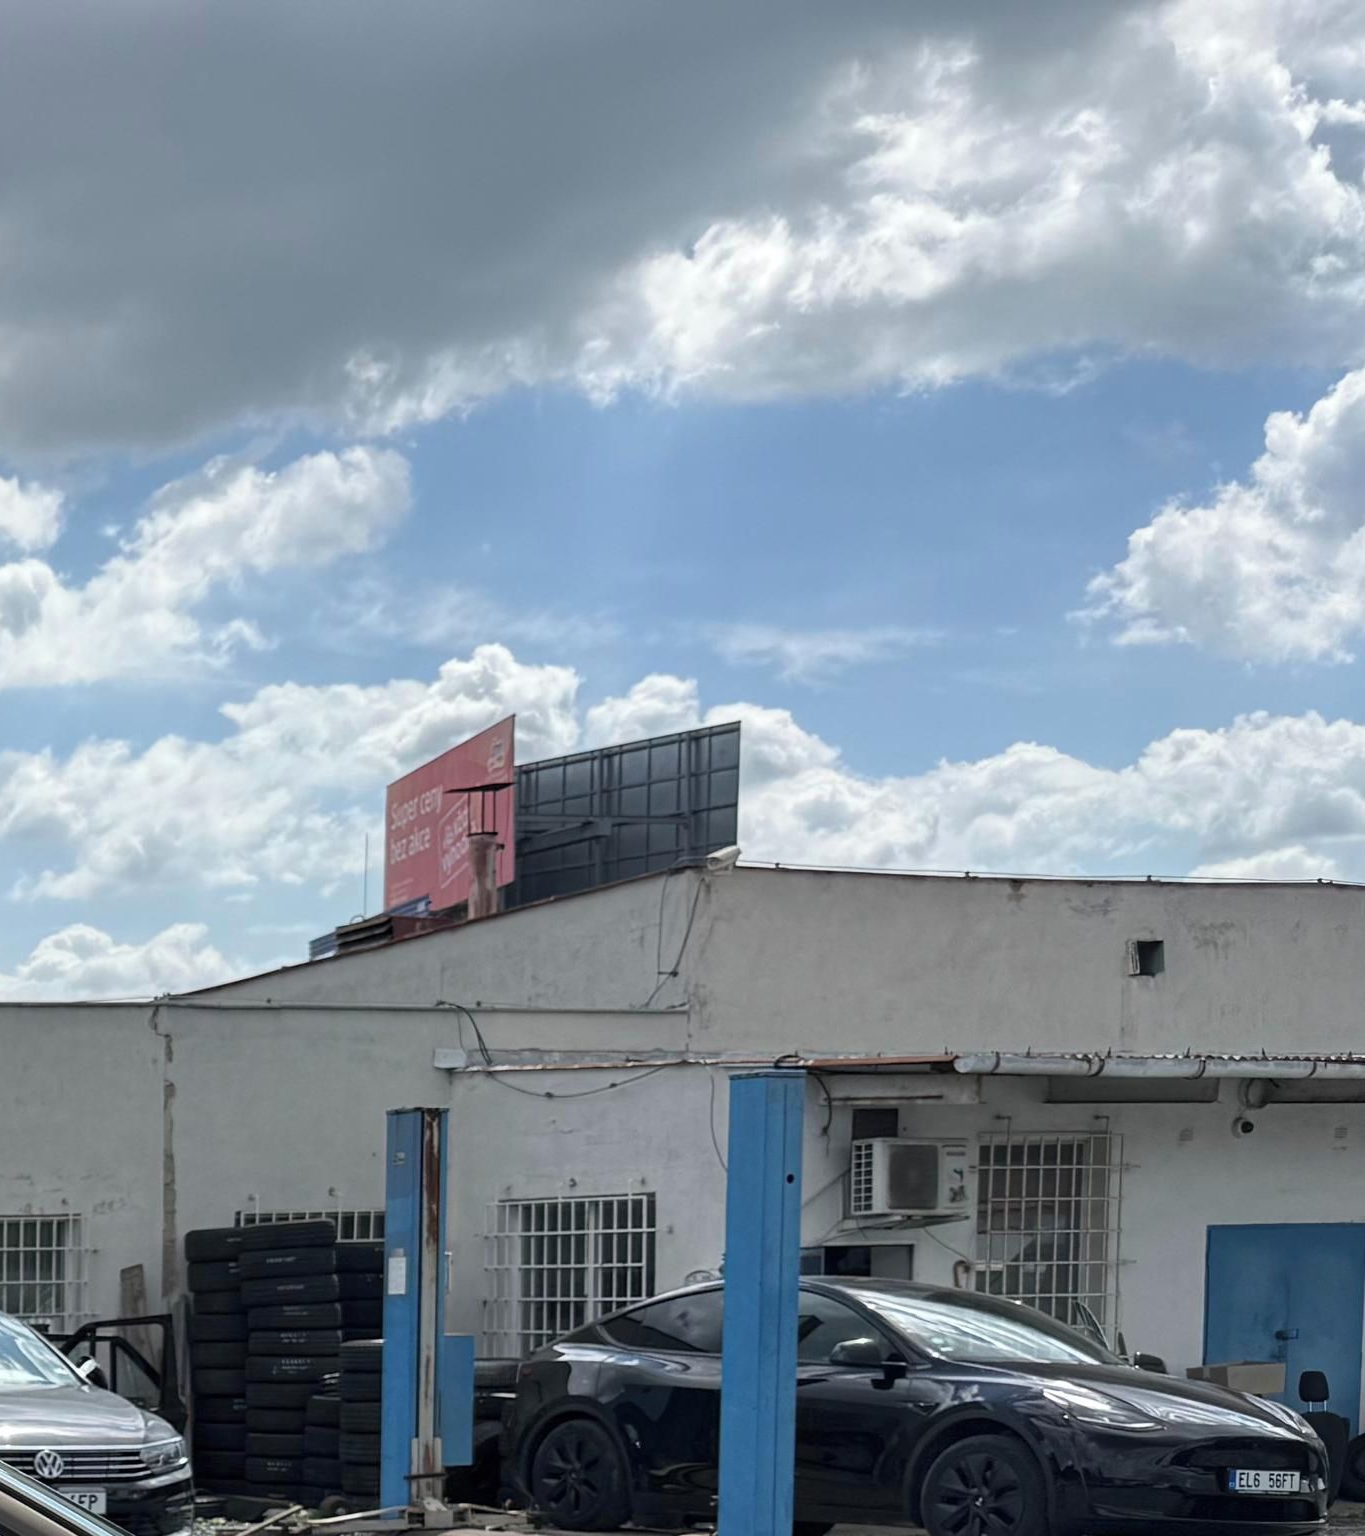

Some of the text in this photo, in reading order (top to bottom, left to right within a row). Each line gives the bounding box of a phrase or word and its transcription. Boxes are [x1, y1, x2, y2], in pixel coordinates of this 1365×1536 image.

[390, 796, 418, 831] Super
[420, 784, 443, 815] ceny
[390, 837, 407, 865] bez
[408, 826, 431, 856] akce
[1237, 1471, 1296, 1489] EL6 56FT
